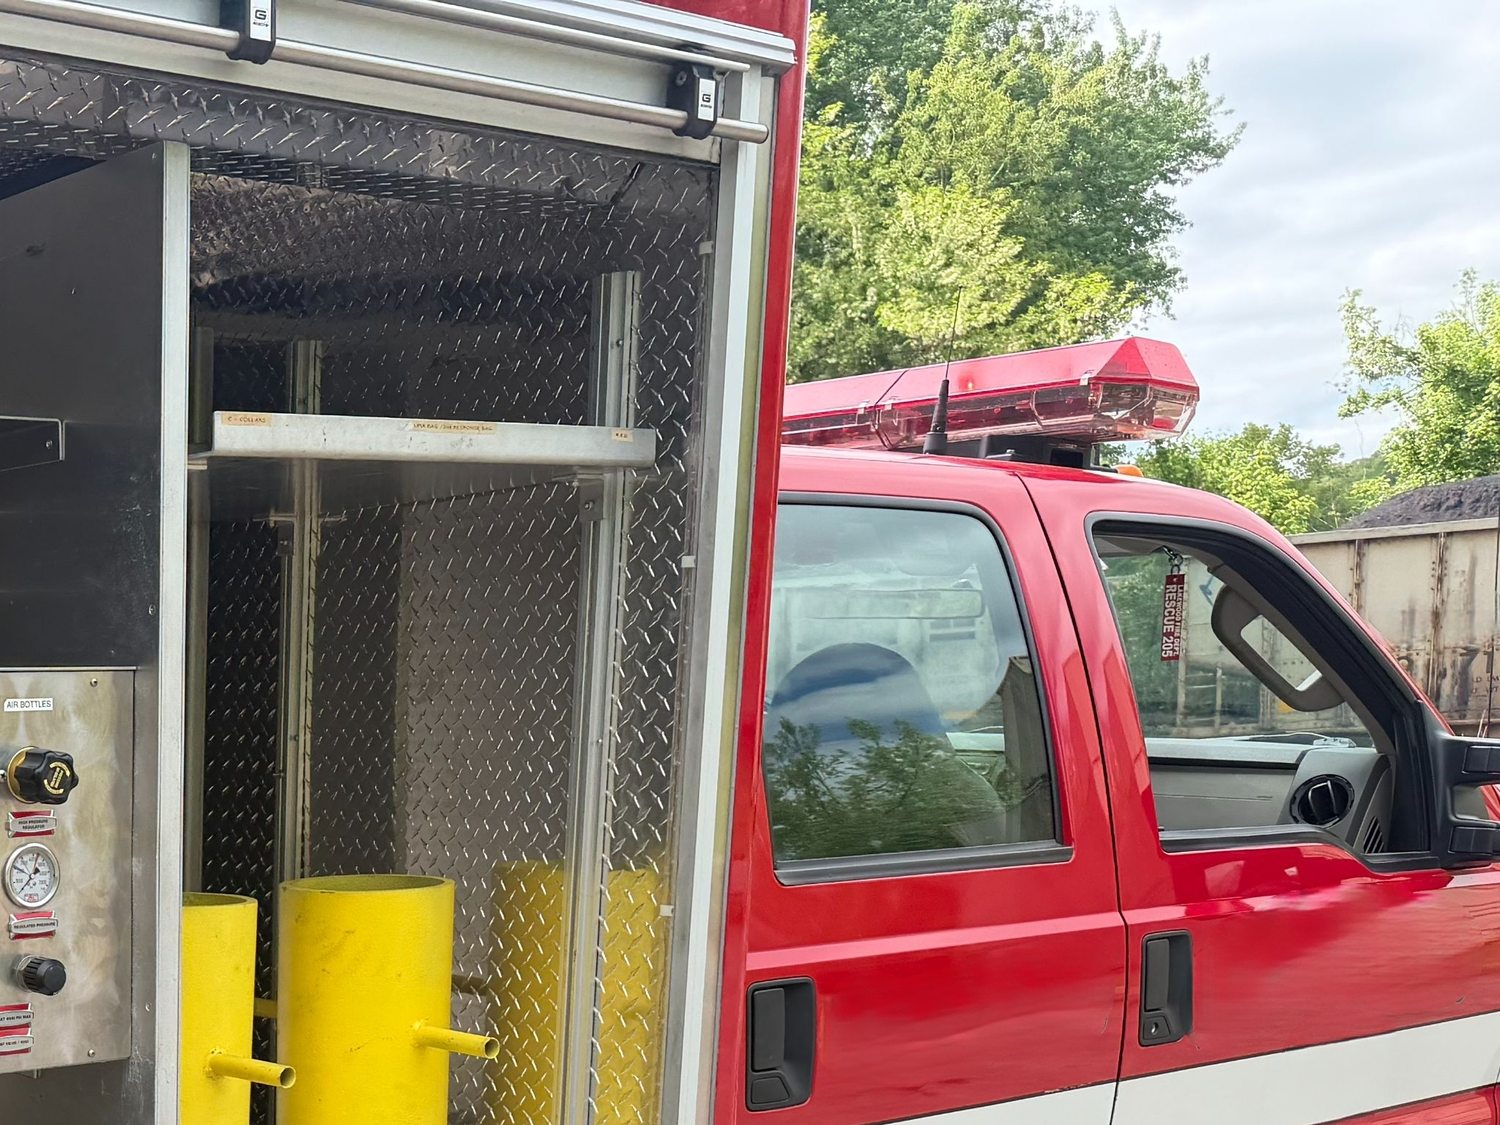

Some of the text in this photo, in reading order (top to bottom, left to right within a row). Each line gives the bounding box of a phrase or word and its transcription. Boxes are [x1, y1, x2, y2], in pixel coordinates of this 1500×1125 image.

[255, 9, 267, 20] G
[702, 93, 711, 103] G
[1161, 584, 1177, 657] RESCUE 205
[6, 700, 52, 709] AIR BOTTLES
